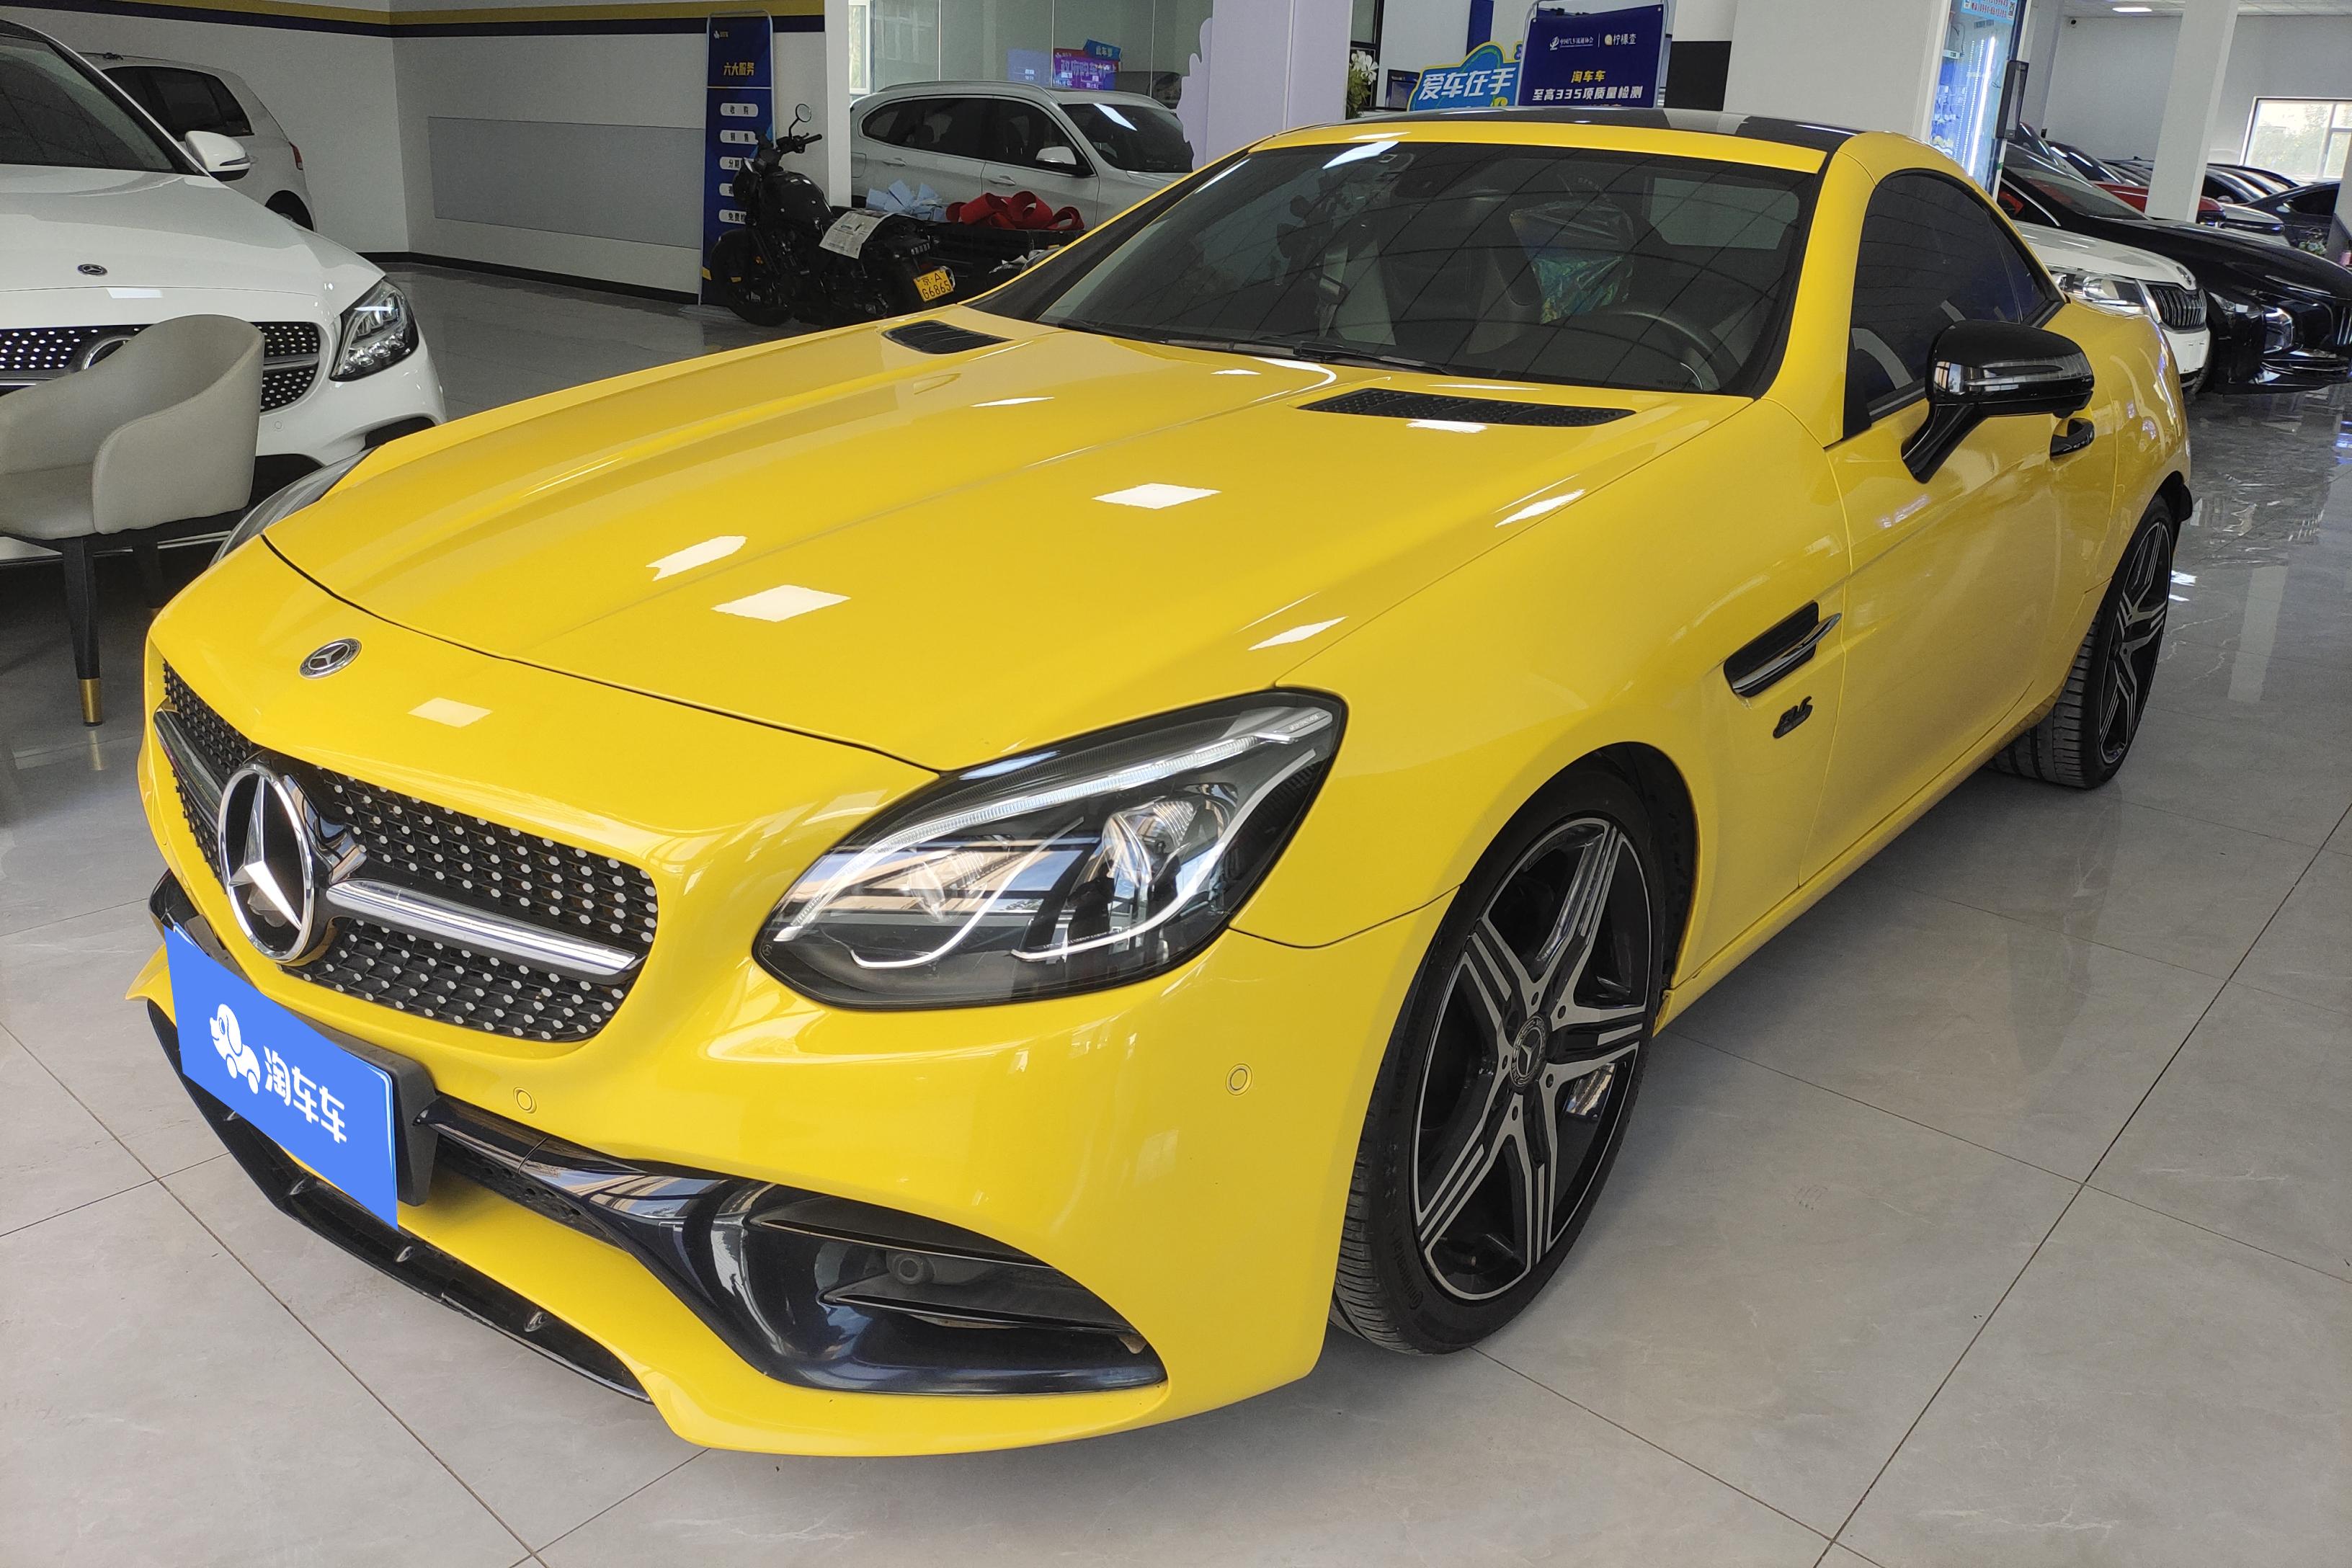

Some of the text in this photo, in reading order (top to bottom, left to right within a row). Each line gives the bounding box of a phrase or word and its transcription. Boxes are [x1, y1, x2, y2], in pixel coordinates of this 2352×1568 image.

[1613, 33, 1637, 46] 柠檬查
[723, 62, 755, 76] 六大服务
[1571, 70, 1606, 83] 淘车车
[1418, 67, 1517, 100] 爱车在手
[1532, 85, 1644, 101] 至高335项质量检测
[922, 280, 951, 300] G6865
